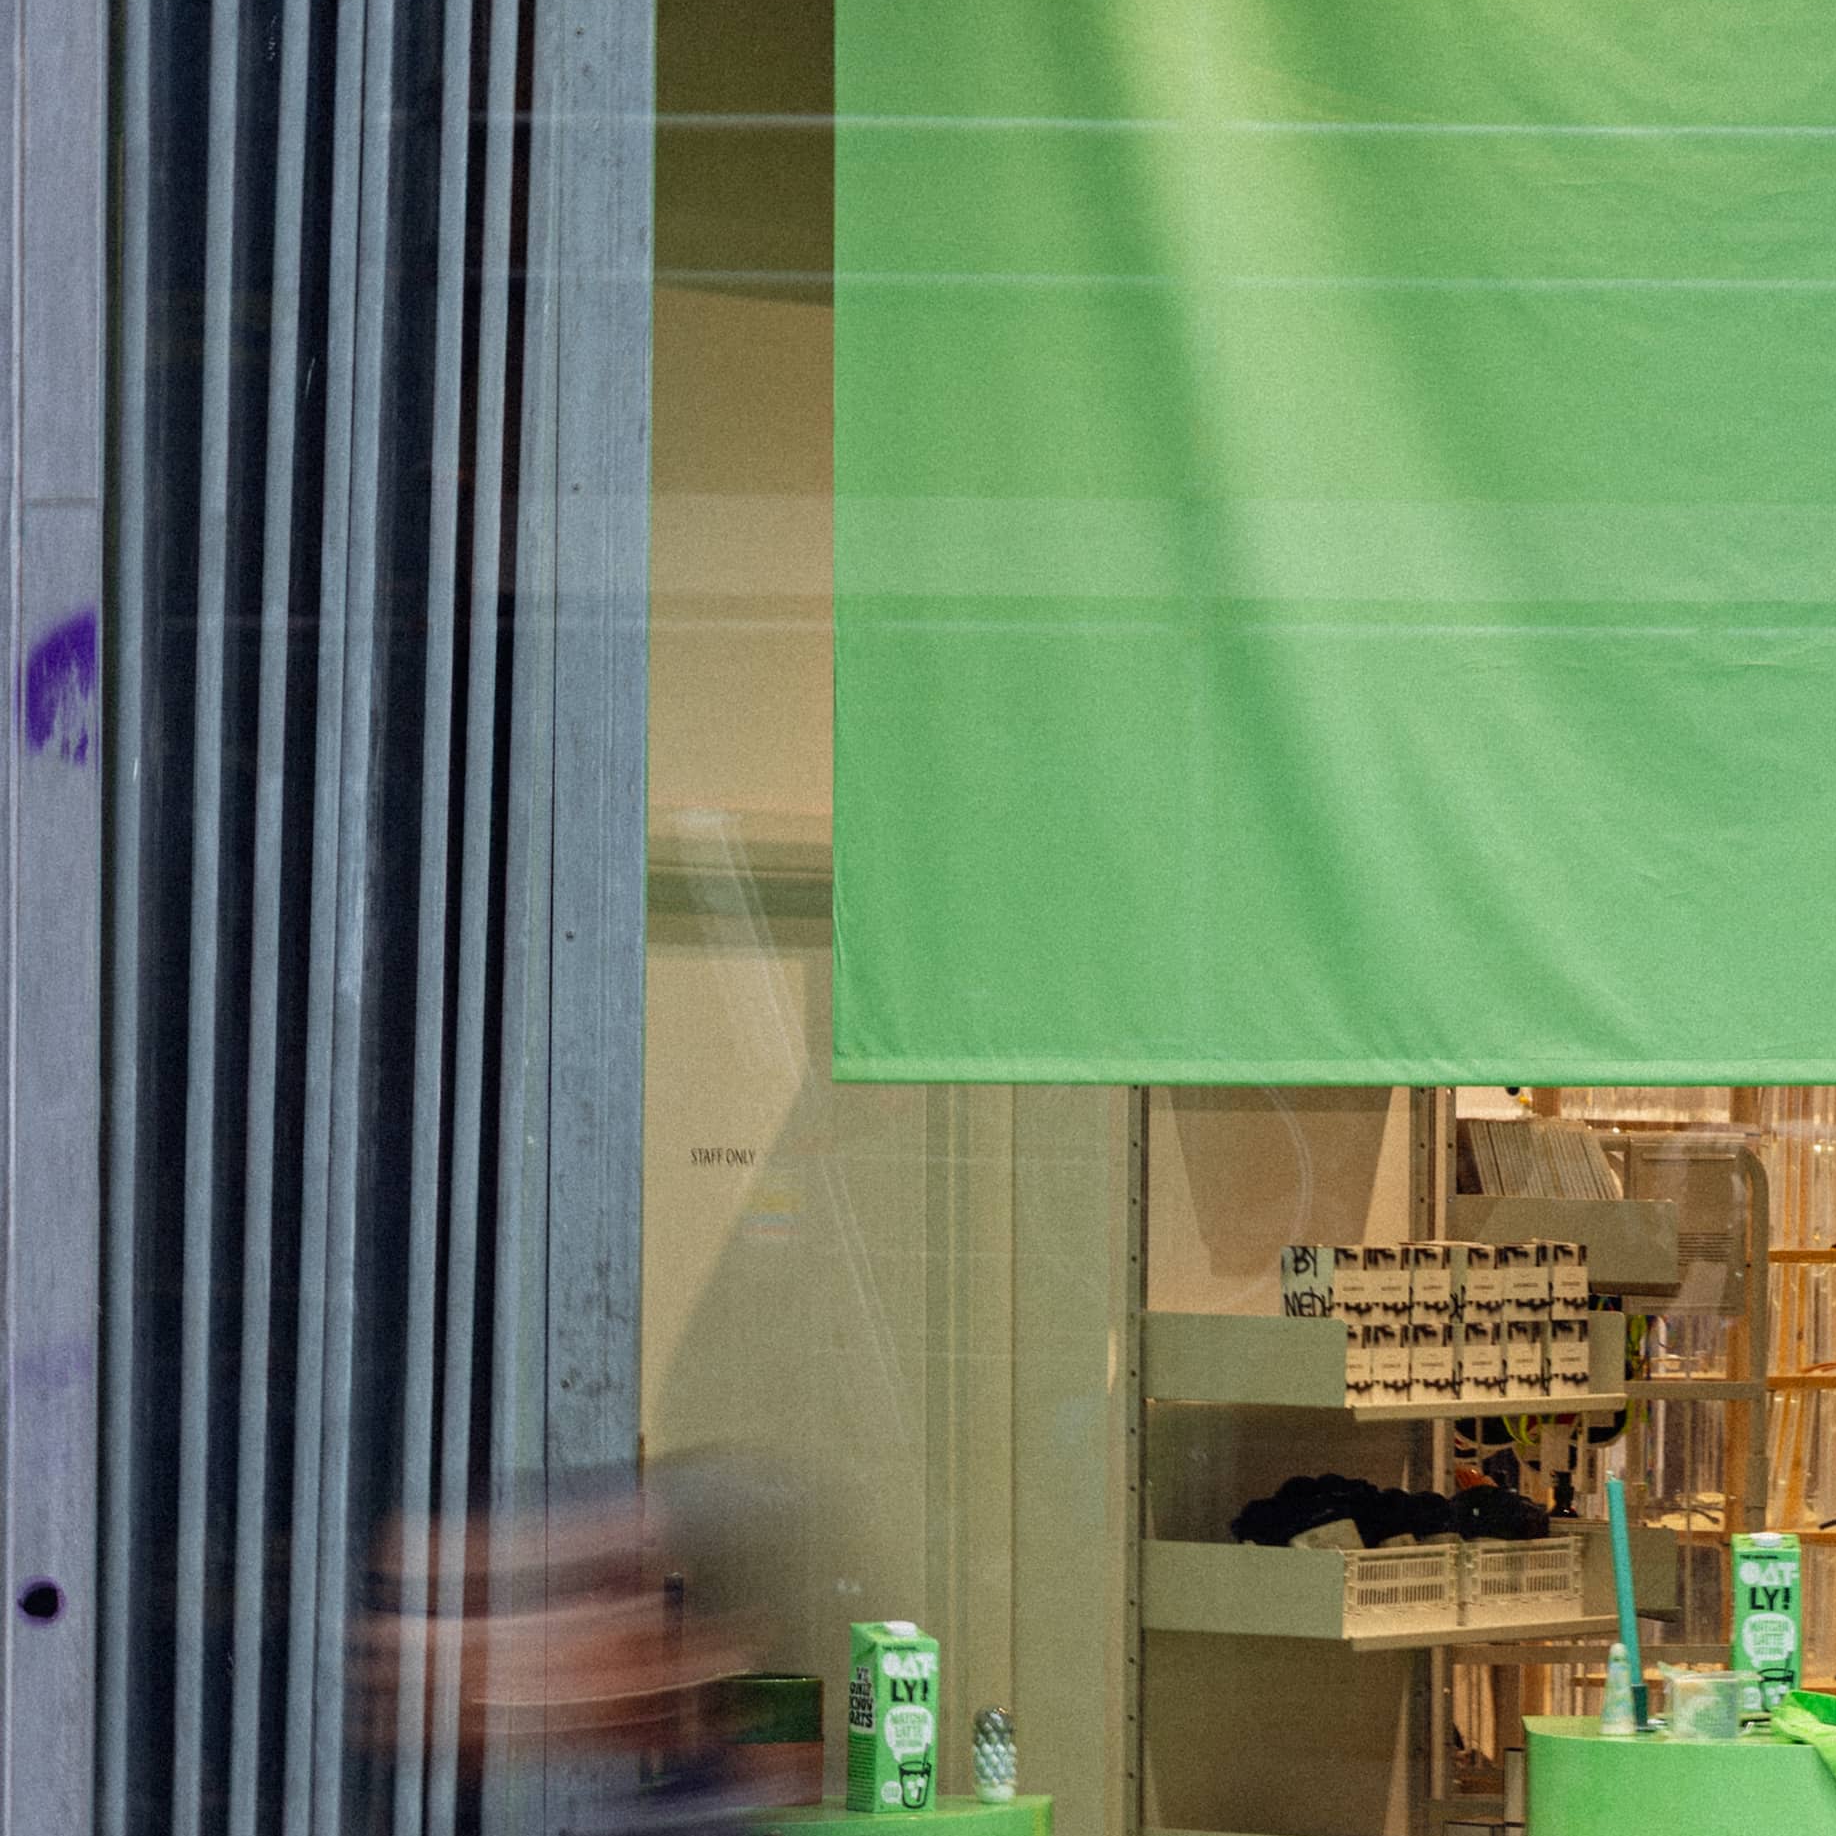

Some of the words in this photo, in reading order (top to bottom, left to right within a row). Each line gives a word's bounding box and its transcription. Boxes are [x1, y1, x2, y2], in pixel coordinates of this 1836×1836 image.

[690, 1147, 722, 1164] STAFF
[726, 1148, 756, 1165] ONLY
[1750, 1586, 1790, 1611] LY!
[891, 1678, 929, 1703] LY!
